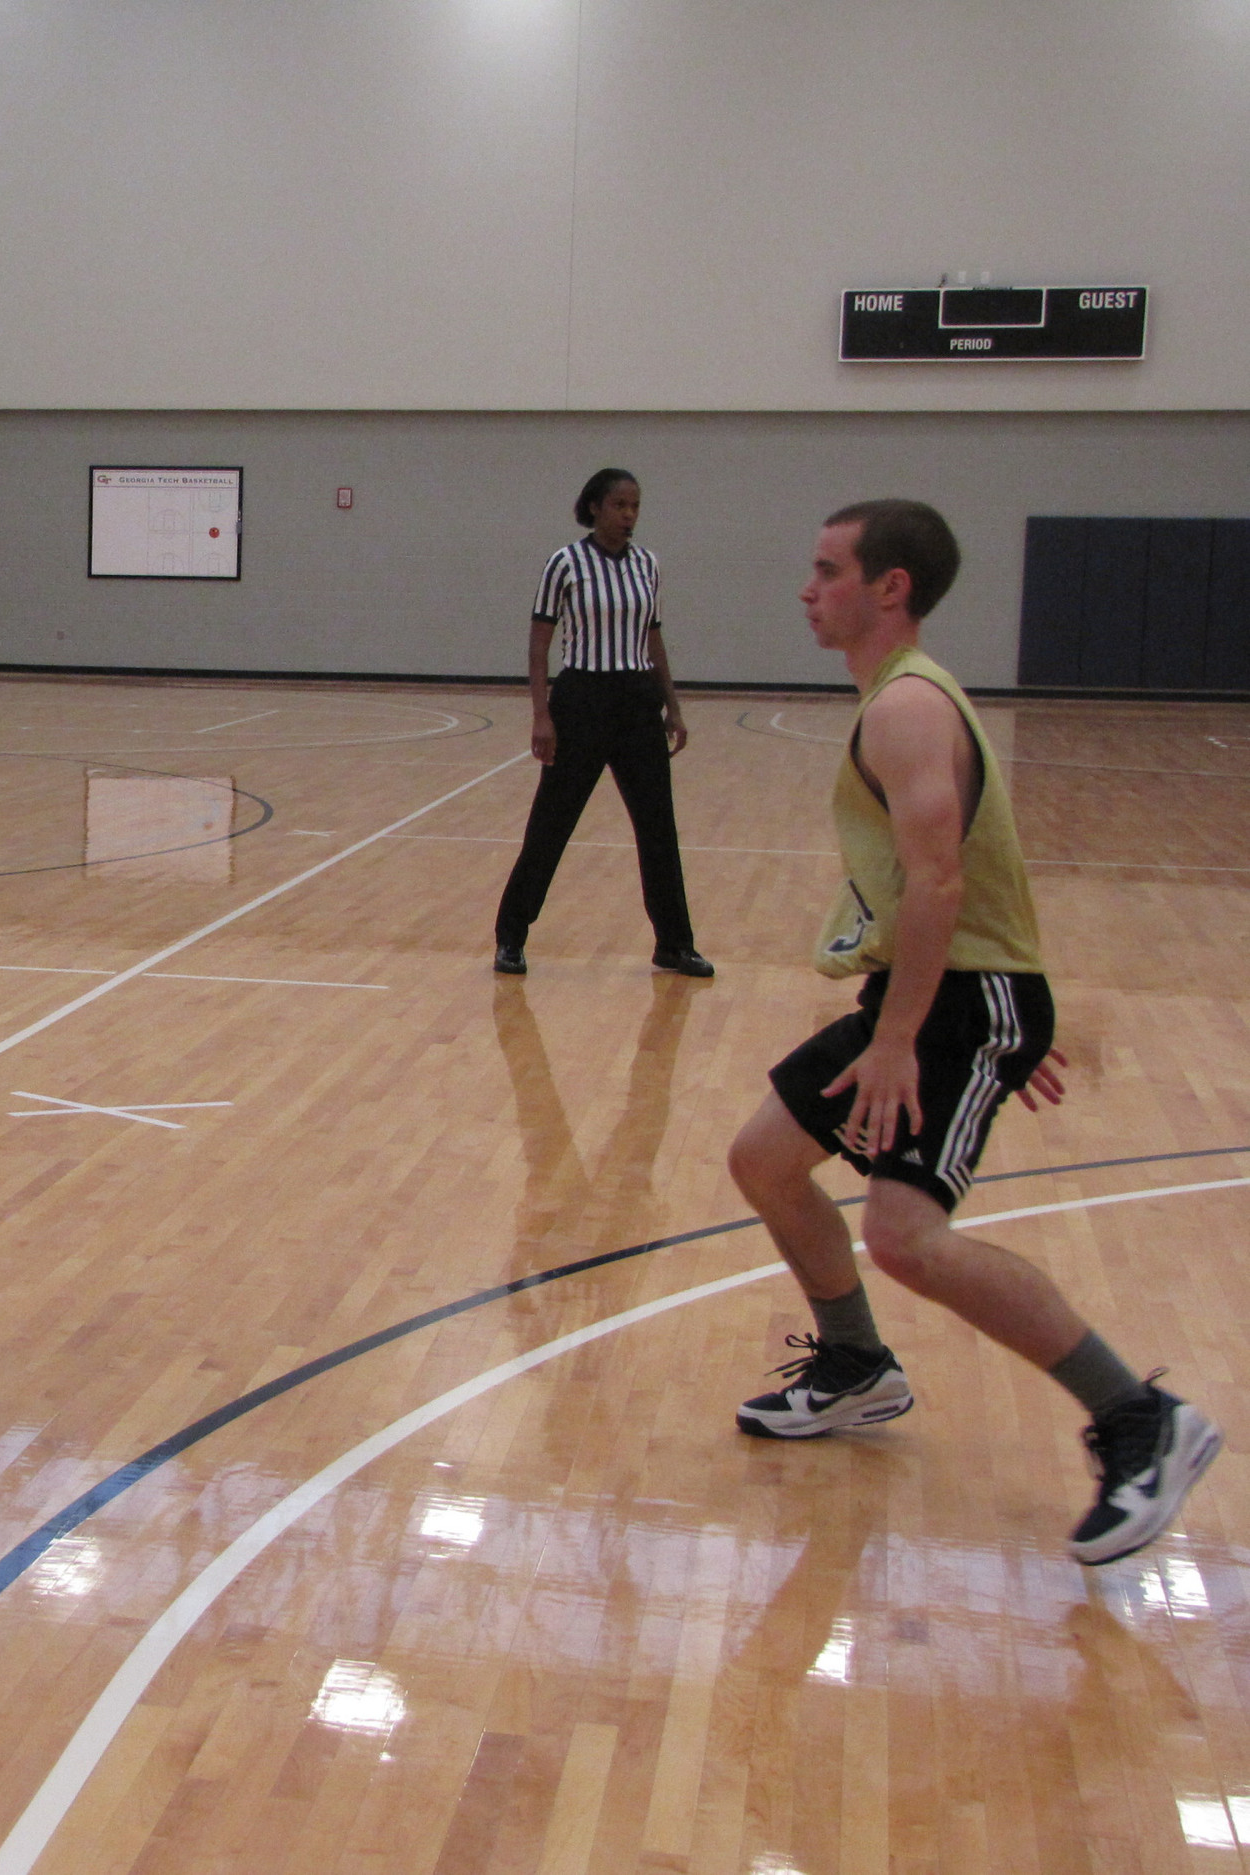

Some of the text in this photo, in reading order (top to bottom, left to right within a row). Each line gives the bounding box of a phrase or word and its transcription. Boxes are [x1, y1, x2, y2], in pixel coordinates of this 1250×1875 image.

[854, 294, 903, 312] HOME
[1079, 291, 1138, 310] GUEST
[950, 338, 992, 351] PERIOD
[182, 477, 234, 485] BASKETBALL
